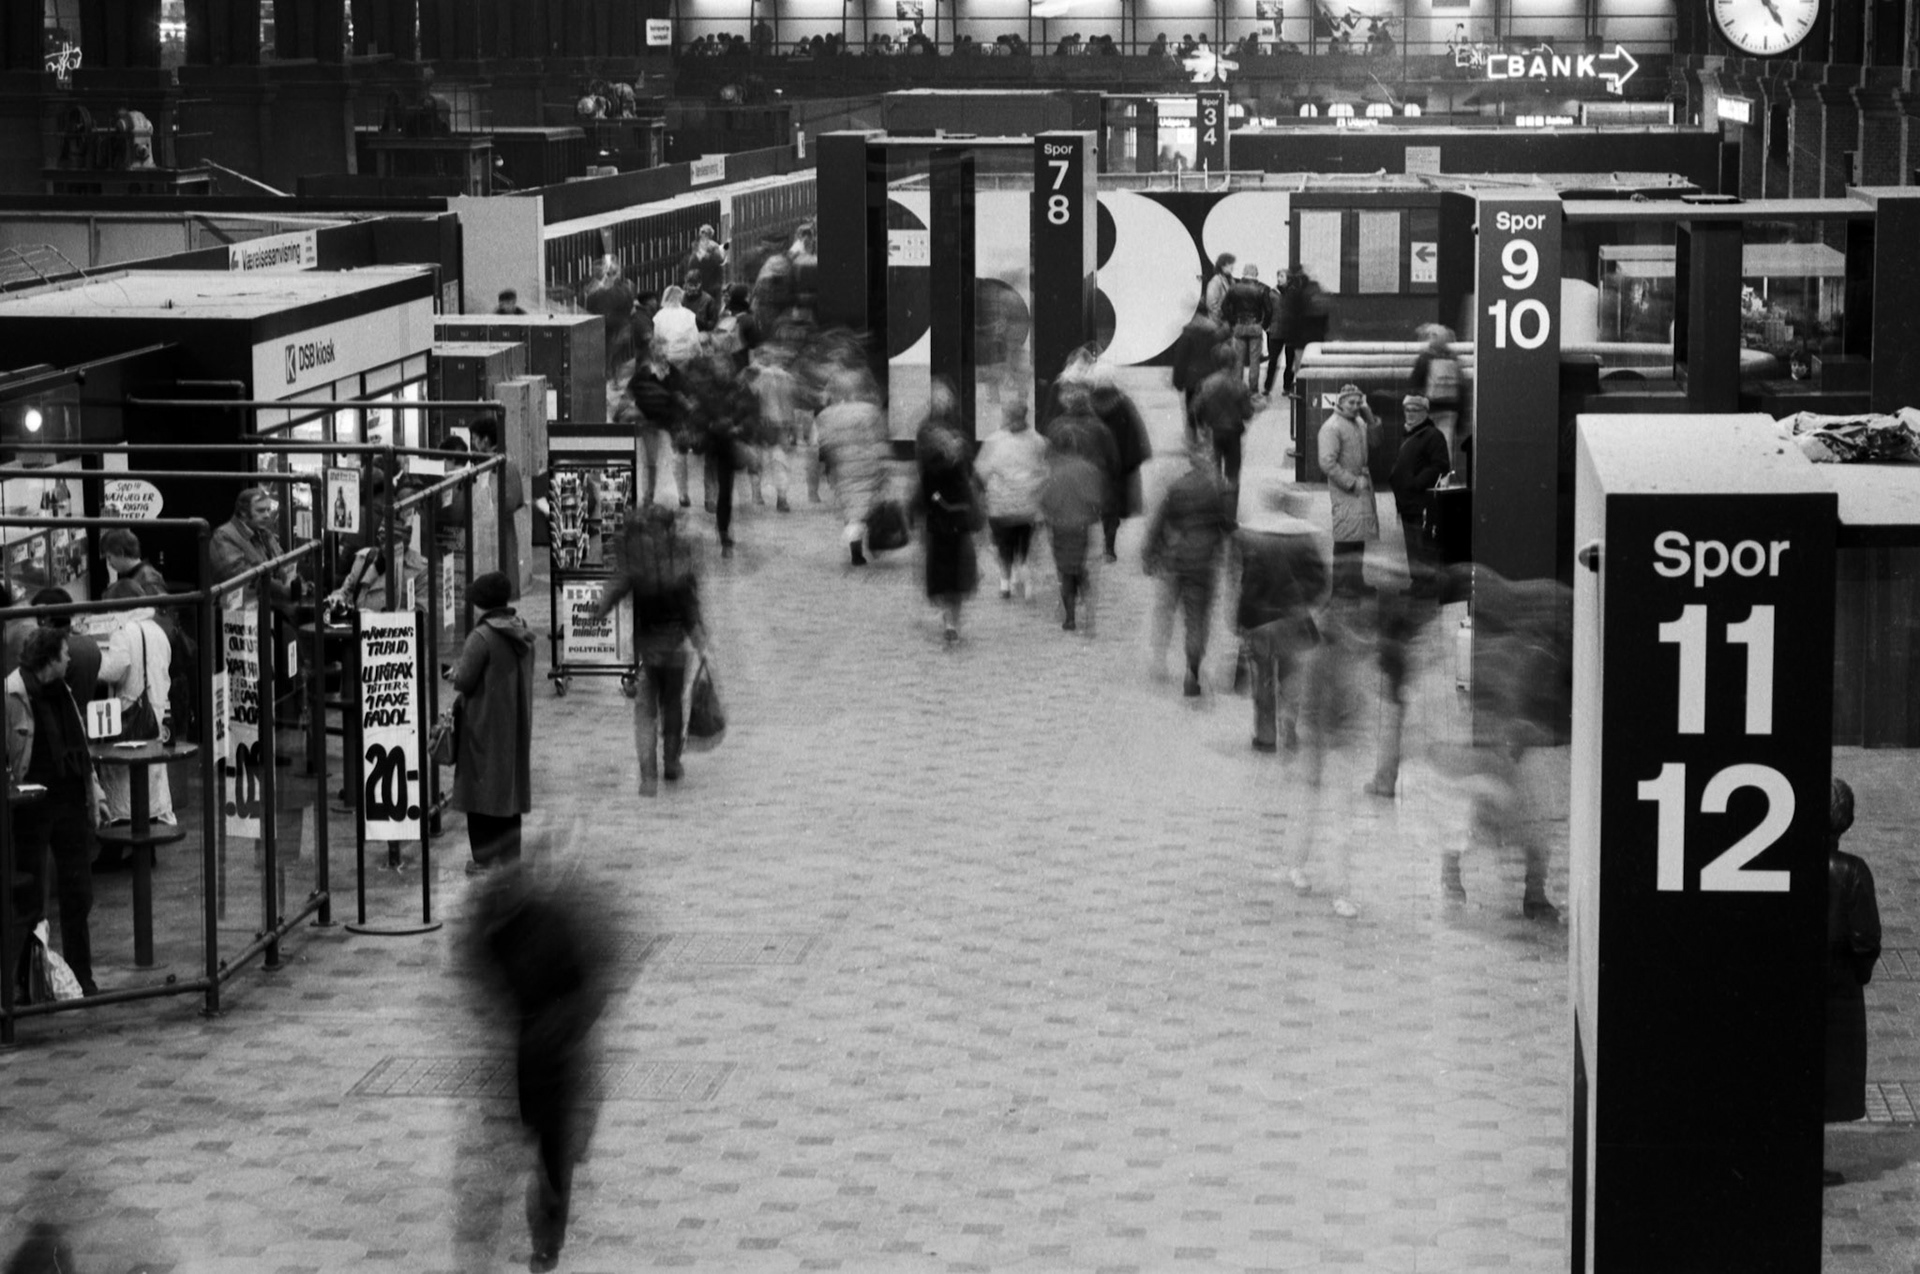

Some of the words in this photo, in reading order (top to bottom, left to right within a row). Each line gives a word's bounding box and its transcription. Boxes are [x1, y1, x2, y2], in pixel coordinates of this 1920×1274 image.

[1508, 55, 1596, 77] BANK
[1202, 98, 1219, 106] Spor
[1204, 108, 1217, 126] 3
[1203, 127, 1217, 145] 4
[1044, 143, 1073, 157] Spor
[1048, 160, 1069, 190] 7
[1047, 194, 1070, 225] 8
[1496, 211, 1546, 234] Spor
[1501, 239, 1539, 290] 9
[1488, 298, 1550, 350] 10
[299, 342, 315, 371] DSB
[315, 338, 335, 366] kiosk
[1653, 530, 1790, 587] Spor
[572, 627, 612, 637] minister
[367, 640, 409, 657] TILBUD
[568, 645, 615, 653] POLITIKEN
[1659, 604, 1775, 735] 11
[375, 692, 409, 708] FAXE
[1637, 762, 1796, 892] 12
